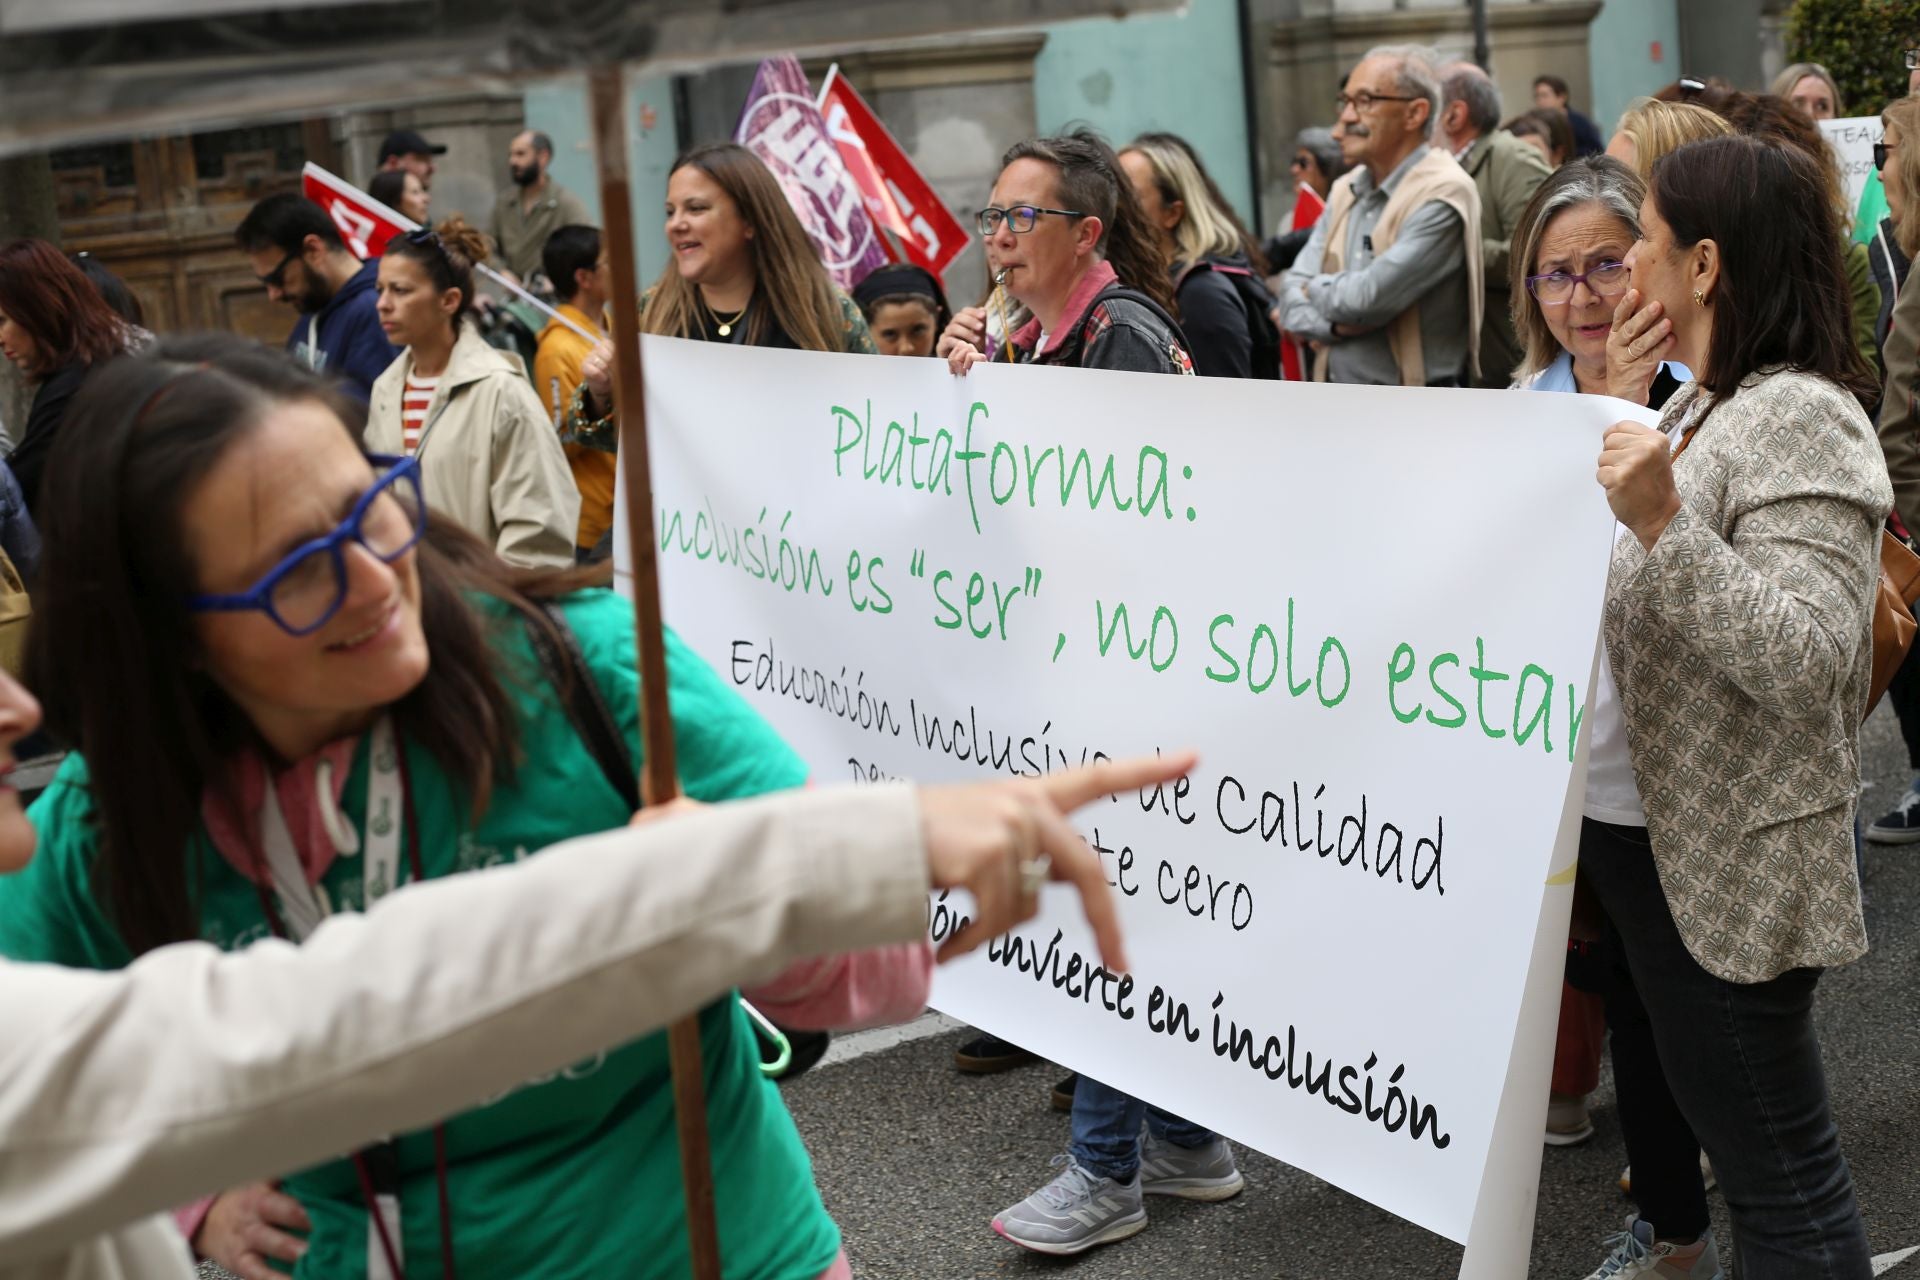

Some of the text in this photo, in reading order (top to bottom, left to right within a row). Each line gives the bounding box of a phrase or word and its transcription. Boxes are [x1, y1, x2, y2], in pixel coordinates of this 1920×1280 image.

[831, 399, 1197, 534] Plataforma:
[659, 495, 833, 597] nclusión
[846, 549, 894, 615] es
[1095, 600, 1179, 673] no
[1203, 596, 1351, 709] solo
[1387, 637, 1585, 763] estar
[732, 637, 900, 737] Educación
[1157, 859, 1253, 932] cero
[988, 927, 1451, 1150] invierte en inclusión
